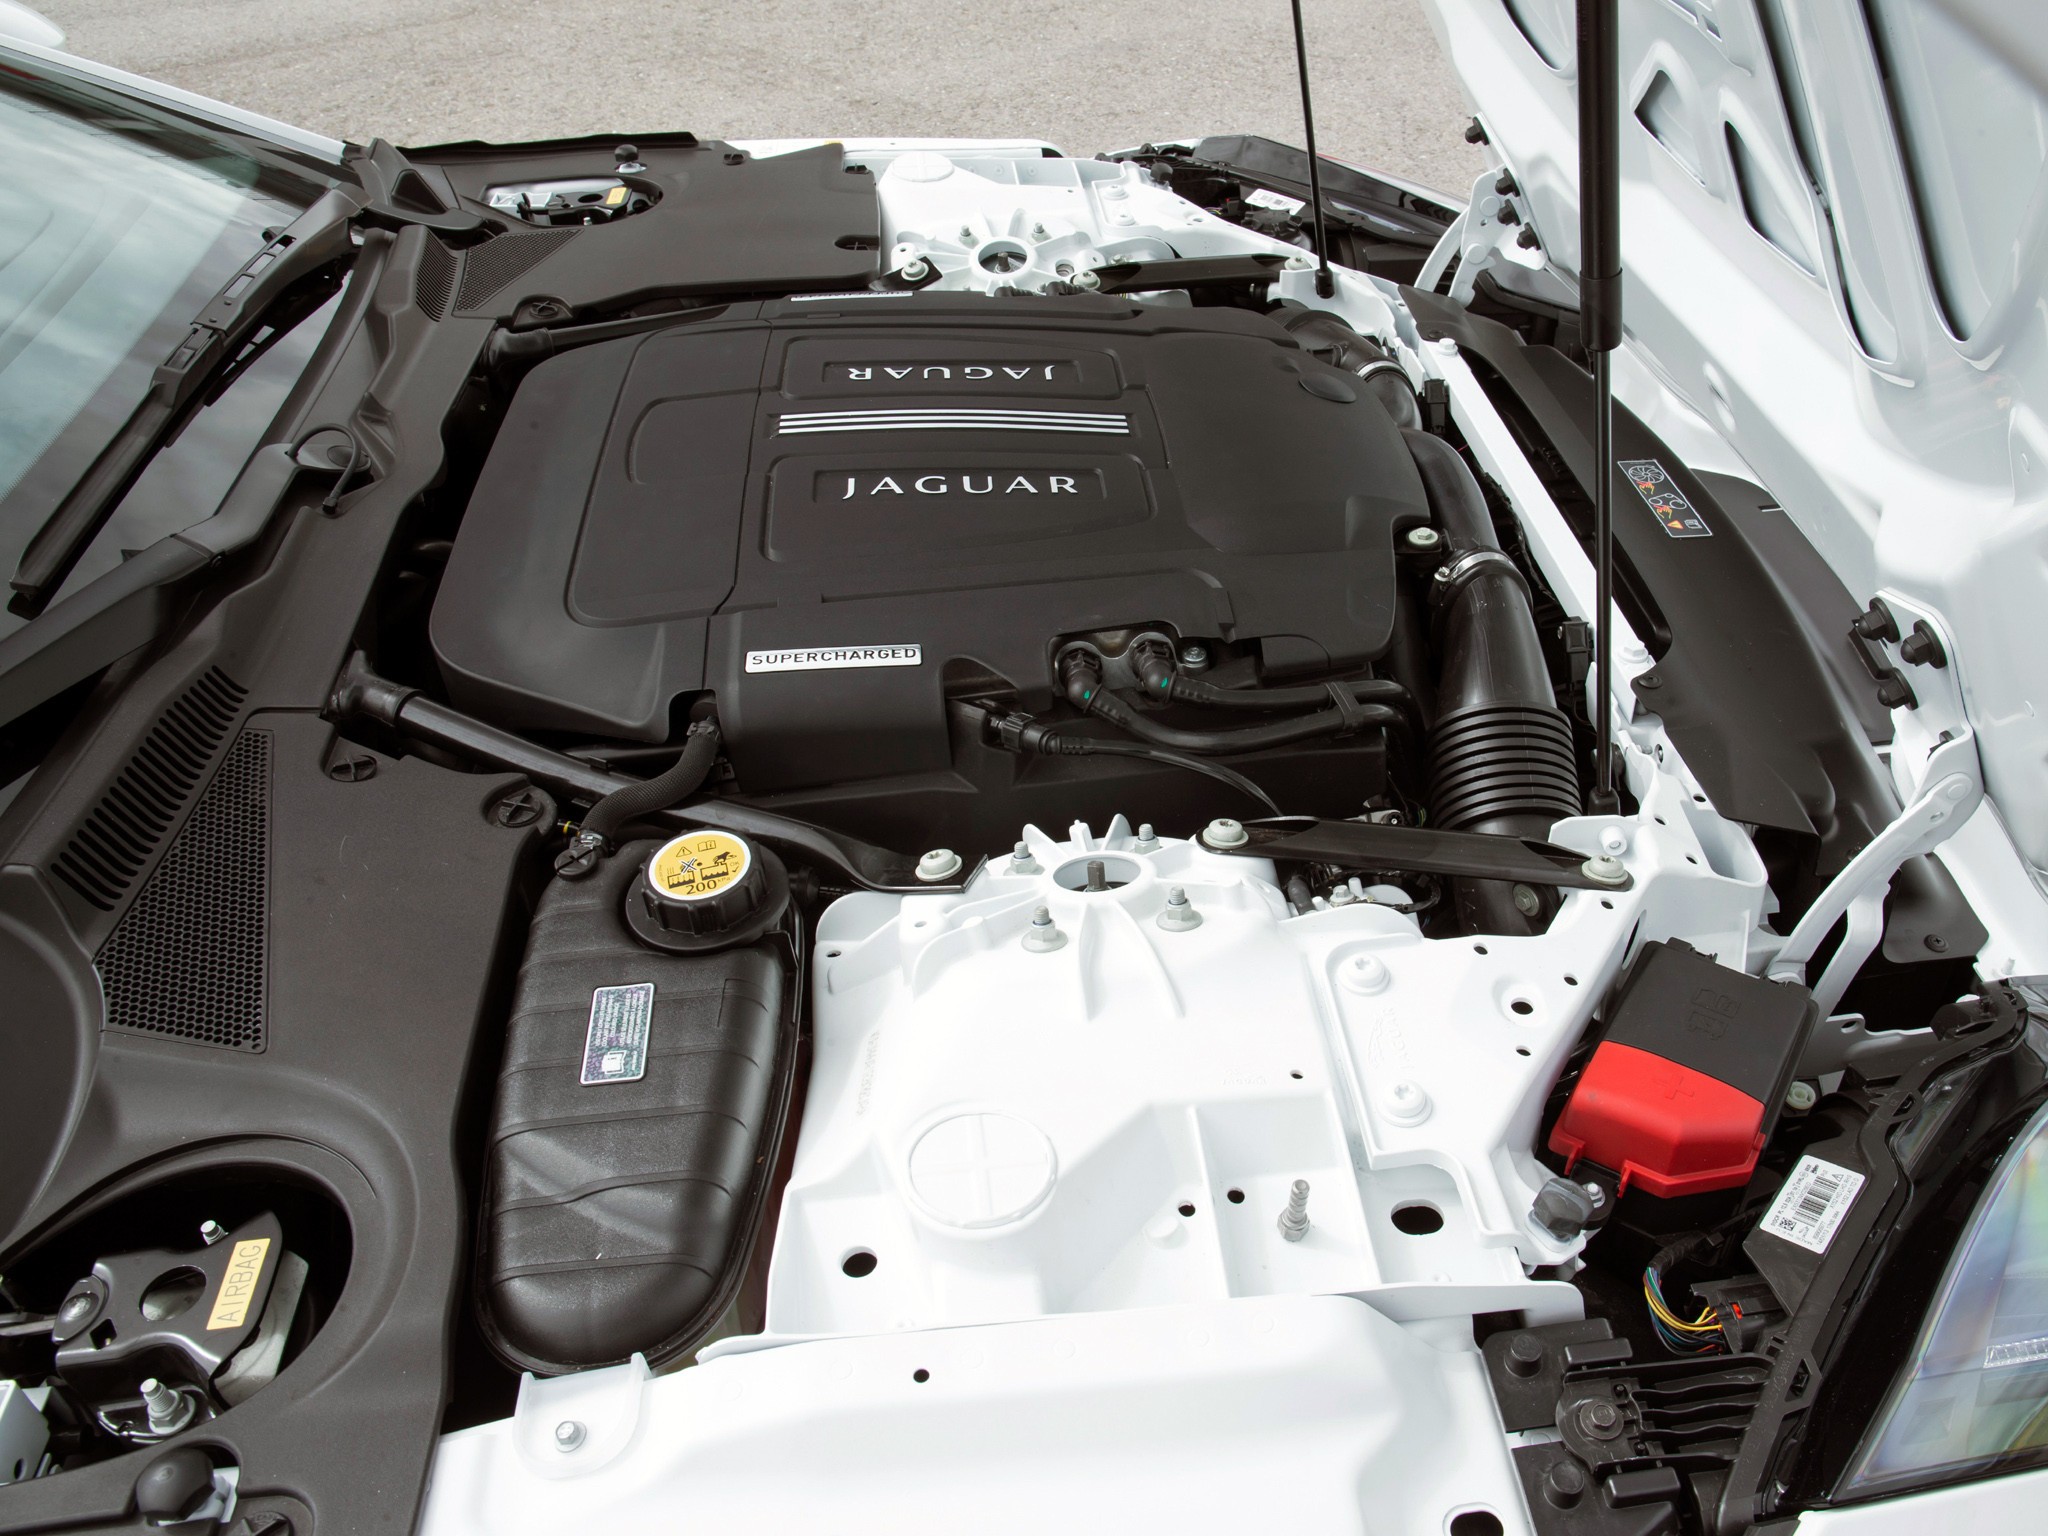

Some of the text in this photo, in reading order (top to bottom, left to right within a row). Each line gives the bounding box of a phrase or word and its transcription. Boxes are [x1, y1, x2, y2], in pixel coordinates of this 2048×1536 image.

[847, 364, 1056, 381] JAGUAR
[842, 475, 1079, 500] JAGUAR
[752, 648, 917, 665] SUPERCHARGED
[686, 879, 717, 895] 200
[216, 1244, 261, 1322] AIRBAG
